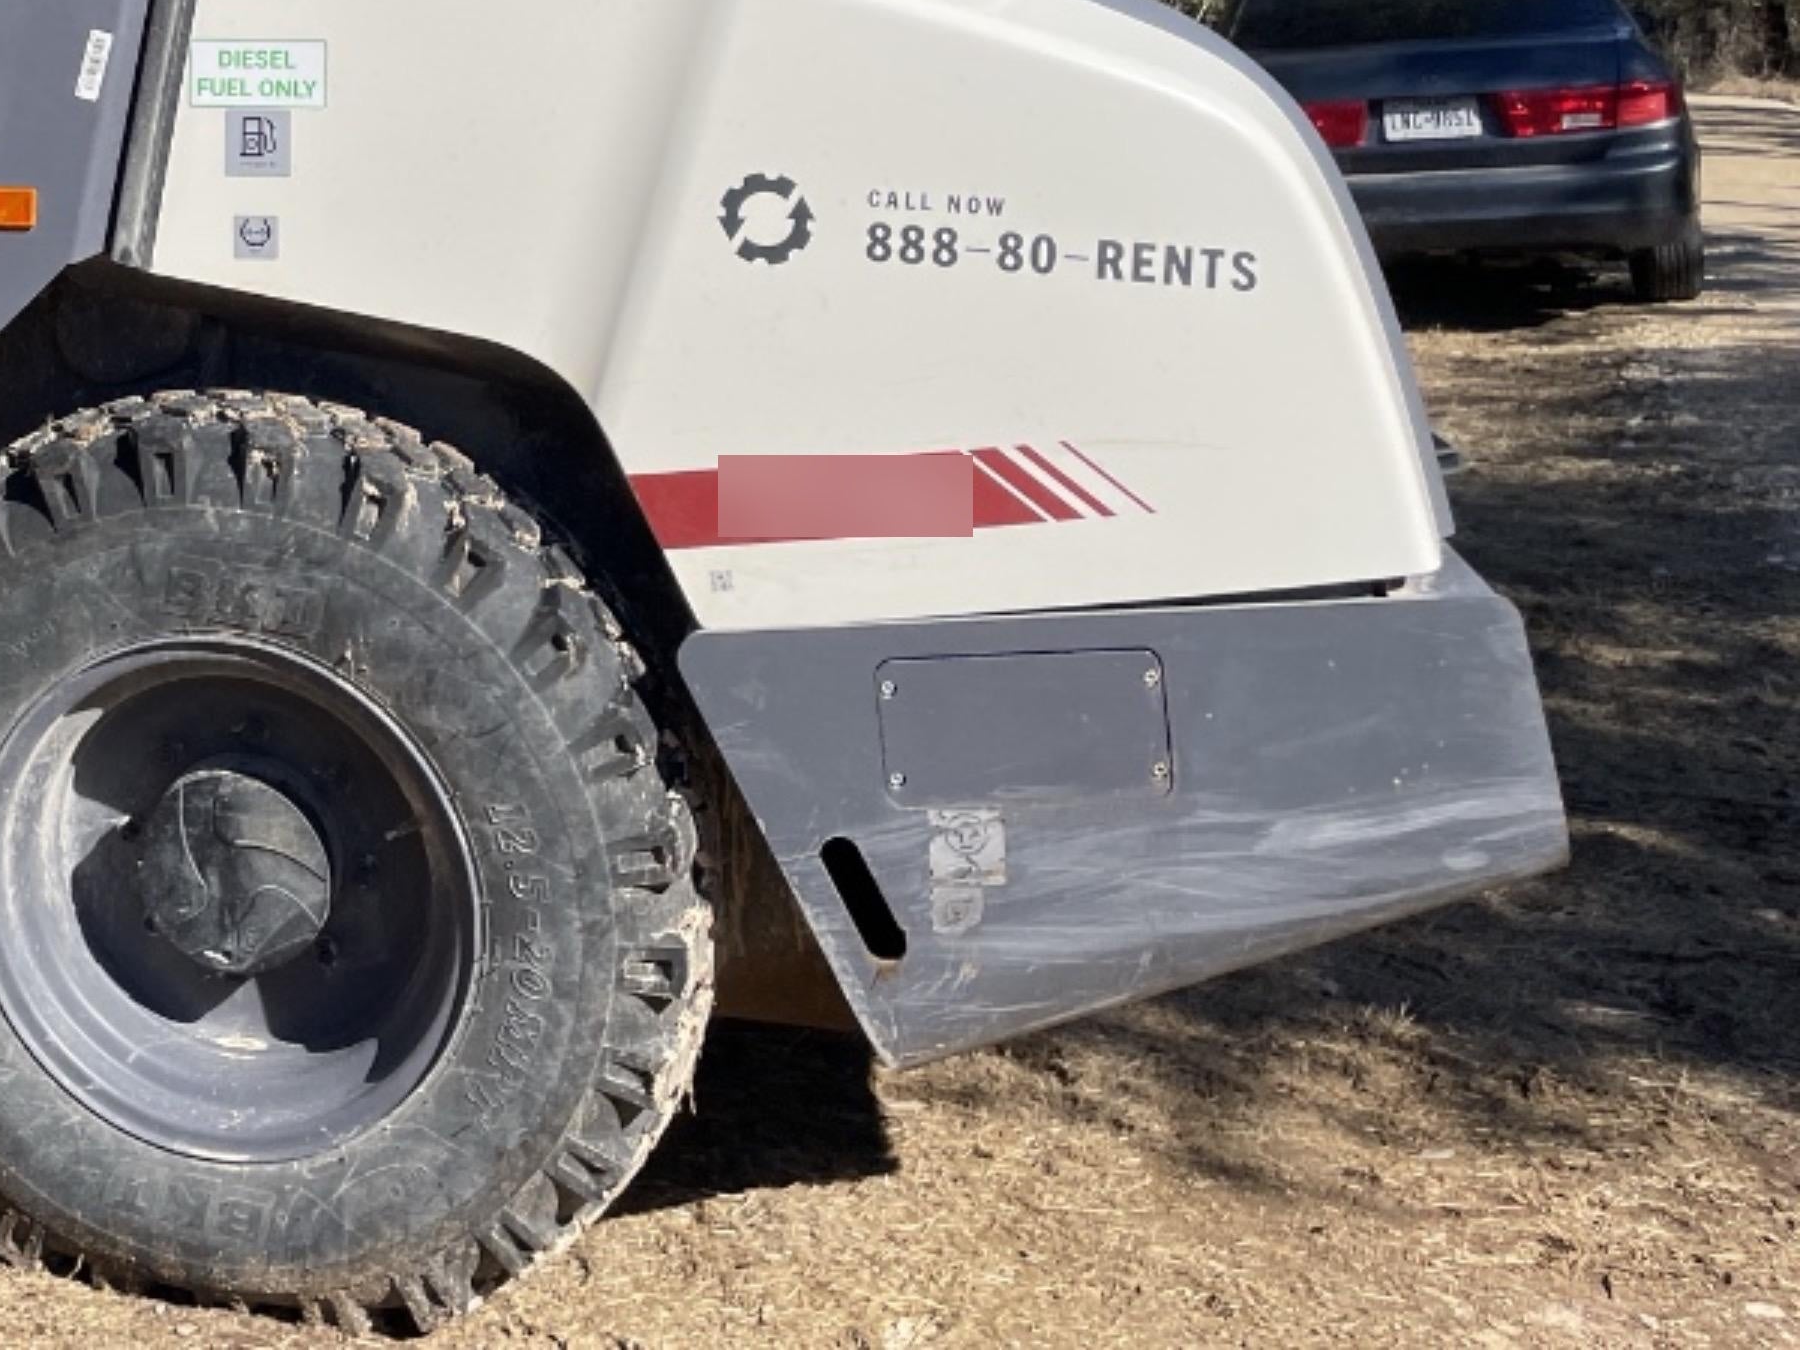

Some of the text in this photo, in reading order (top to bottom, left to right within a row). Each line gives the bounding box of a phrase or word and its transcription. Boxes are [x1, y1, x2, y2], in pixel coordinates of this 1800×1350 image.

[217, 48, 296, 70] DIESEL
[196, 77, 317, 99] FUEL ONLY
[867, 189, 1006, 217] CALL NOW
[866, 221, 1258, 293] 888-80-RENTS
